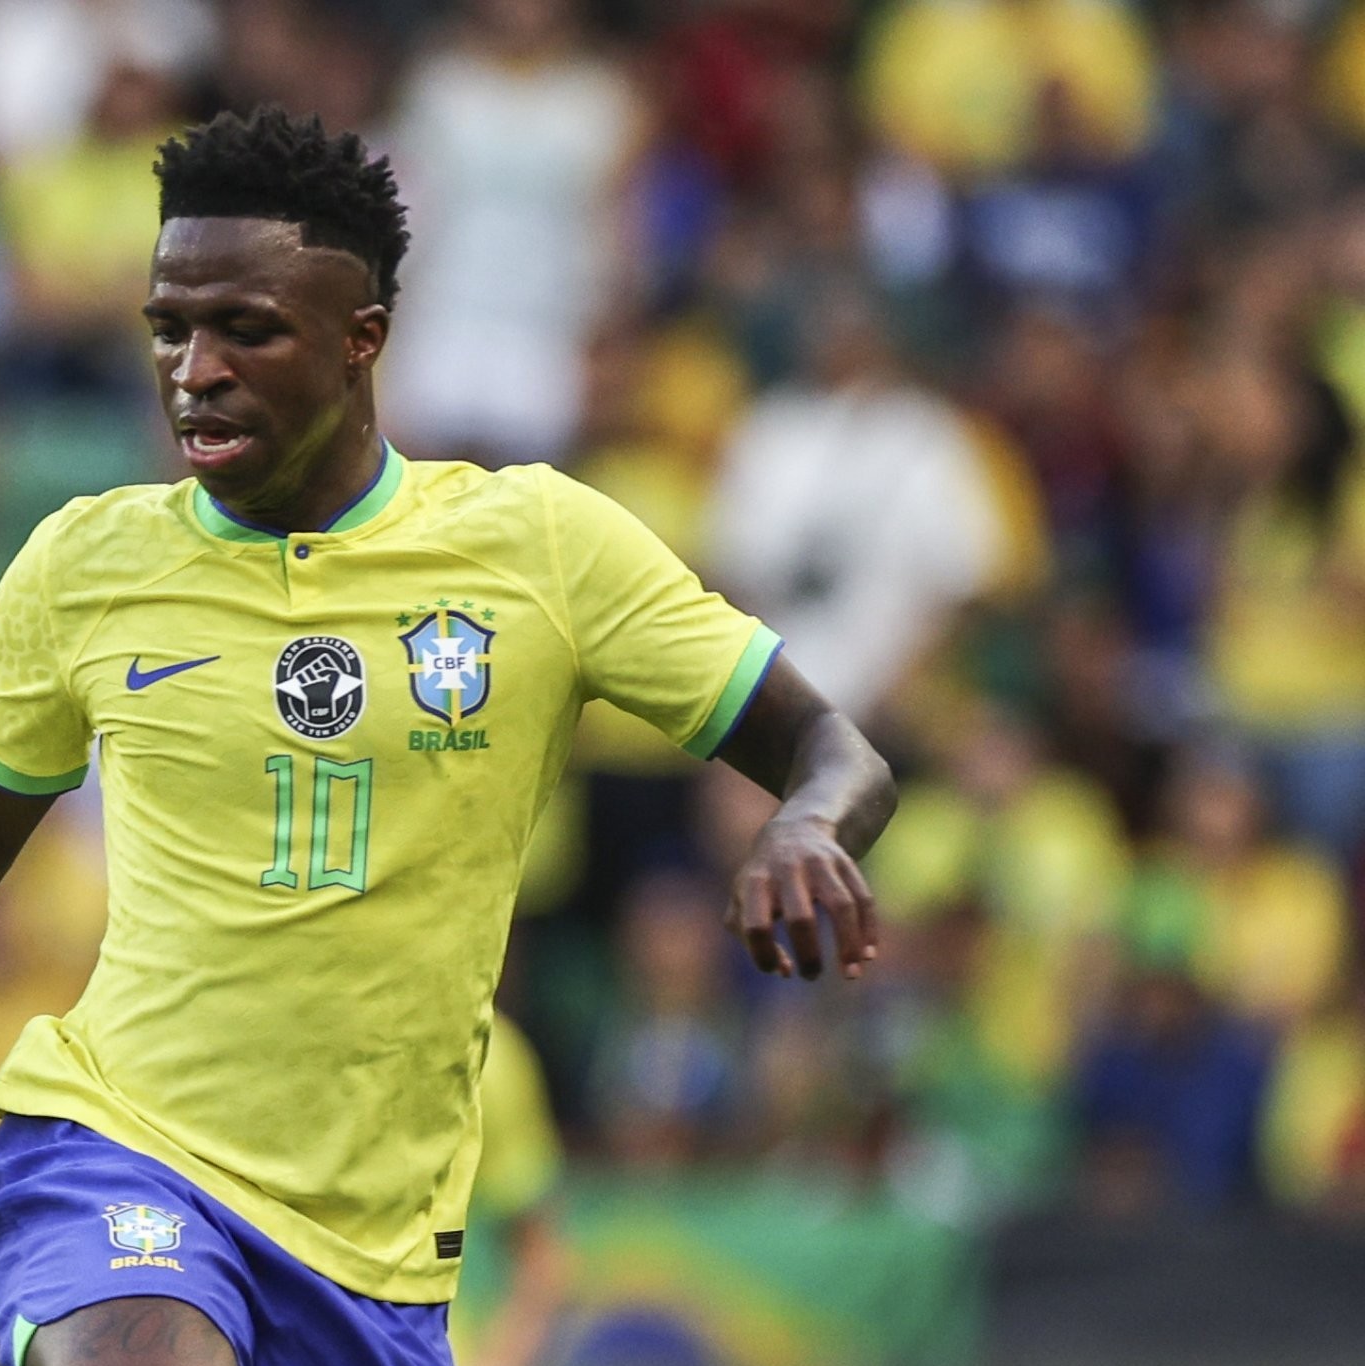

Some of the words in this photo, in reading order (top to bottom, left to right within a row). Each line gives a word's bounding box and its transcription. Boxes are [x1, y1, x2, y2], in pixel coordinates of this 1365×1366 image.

[433, 657, 466, 670] CBF
[408, 729, 491, 752] BRASIL
[260, 754, 373, 893] 10
[109, 1254, 186, 1273] BRASIL
